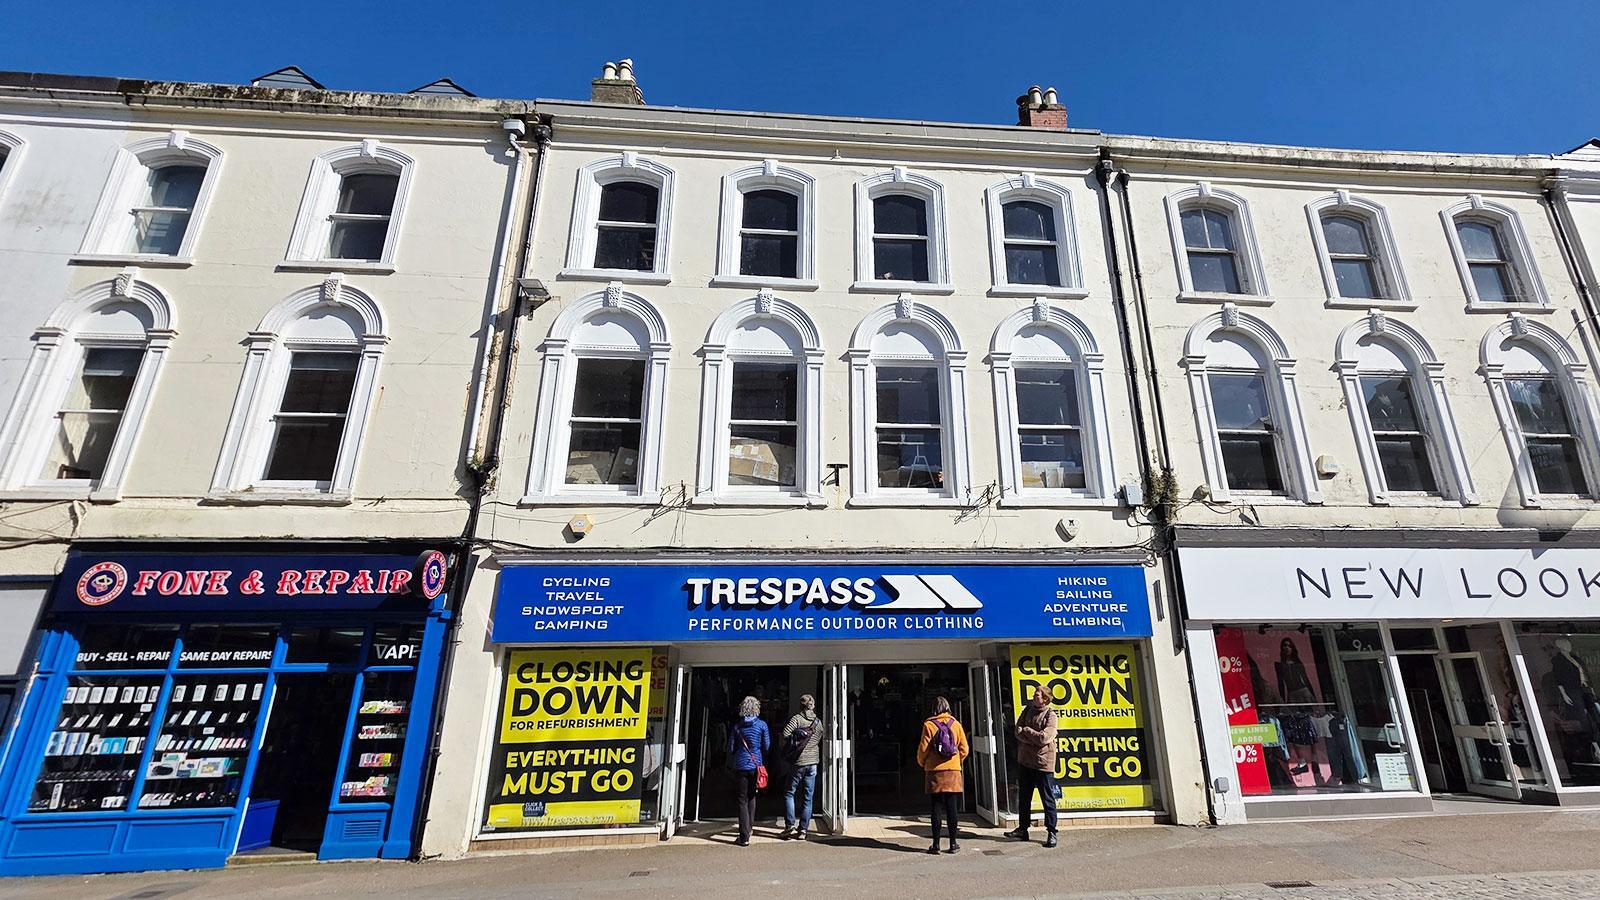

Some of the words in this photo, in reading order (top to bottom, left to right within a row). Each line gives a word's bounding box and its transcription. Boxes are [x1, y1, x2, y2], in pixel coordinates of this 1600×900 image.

[132, 569, 232, 596] FONE
[239, 570, 265, 595] &
[276, 569, 411, 596] REPAIR
[542, 577, 610, 587] CYCLING
[1058, 577, 1107, 586] HIKING
[1296, 567, 1423, 599] NEW
[1460, 567, 1600, 599] LOOK
[546, 591, 604, 601] TRAVEL
[687, 577, 876, 605] TRESPASS
[1056, 590, 1112, 599] SAILING
[521, 605, 624, 615] SNOWSPORT
[1043, 603, 1128, 613] ADVENTURE
[534, 620, 608, 630] CAMPING
[688, 617, 814, 631] PERFORMANCE
[820, 616, 898, 630] OUTDOOR
[904, 616, 984, 629] CLOTHING
[1052, 617, 1122, 627] CLIMBING
[76, 652, 100, 662] BUY
[106, 652, 128, 662] SELL
[179, 651, 210, 662] SAME
[211, 651, 232, 661] DAY
[373, 643, 420, 660] VAPE
[516, 660, 644, 684] CLOSING
[1018, 655, 1130, 675] CLOSING
[1019, 678, 1134, 706] DOWN
[511, 685, 643, 717] DOWN
[1225, 693, 1252, 716] ALE
[510, 721, 534, 731] FOR
[537, 717, 640, 730] REFURBISHMENT
[1247, 726, 1269, 734] LINES
[1238, 735, 1264, 743] ADDED
[506, 747, 636, 769] EVERYTHING
[1053, 757, 1099, 779] UST
[1104, 755, 1142, 778] GO
[501, 771, 586, 797] MUST
[591, 768, 634, 793] GO
